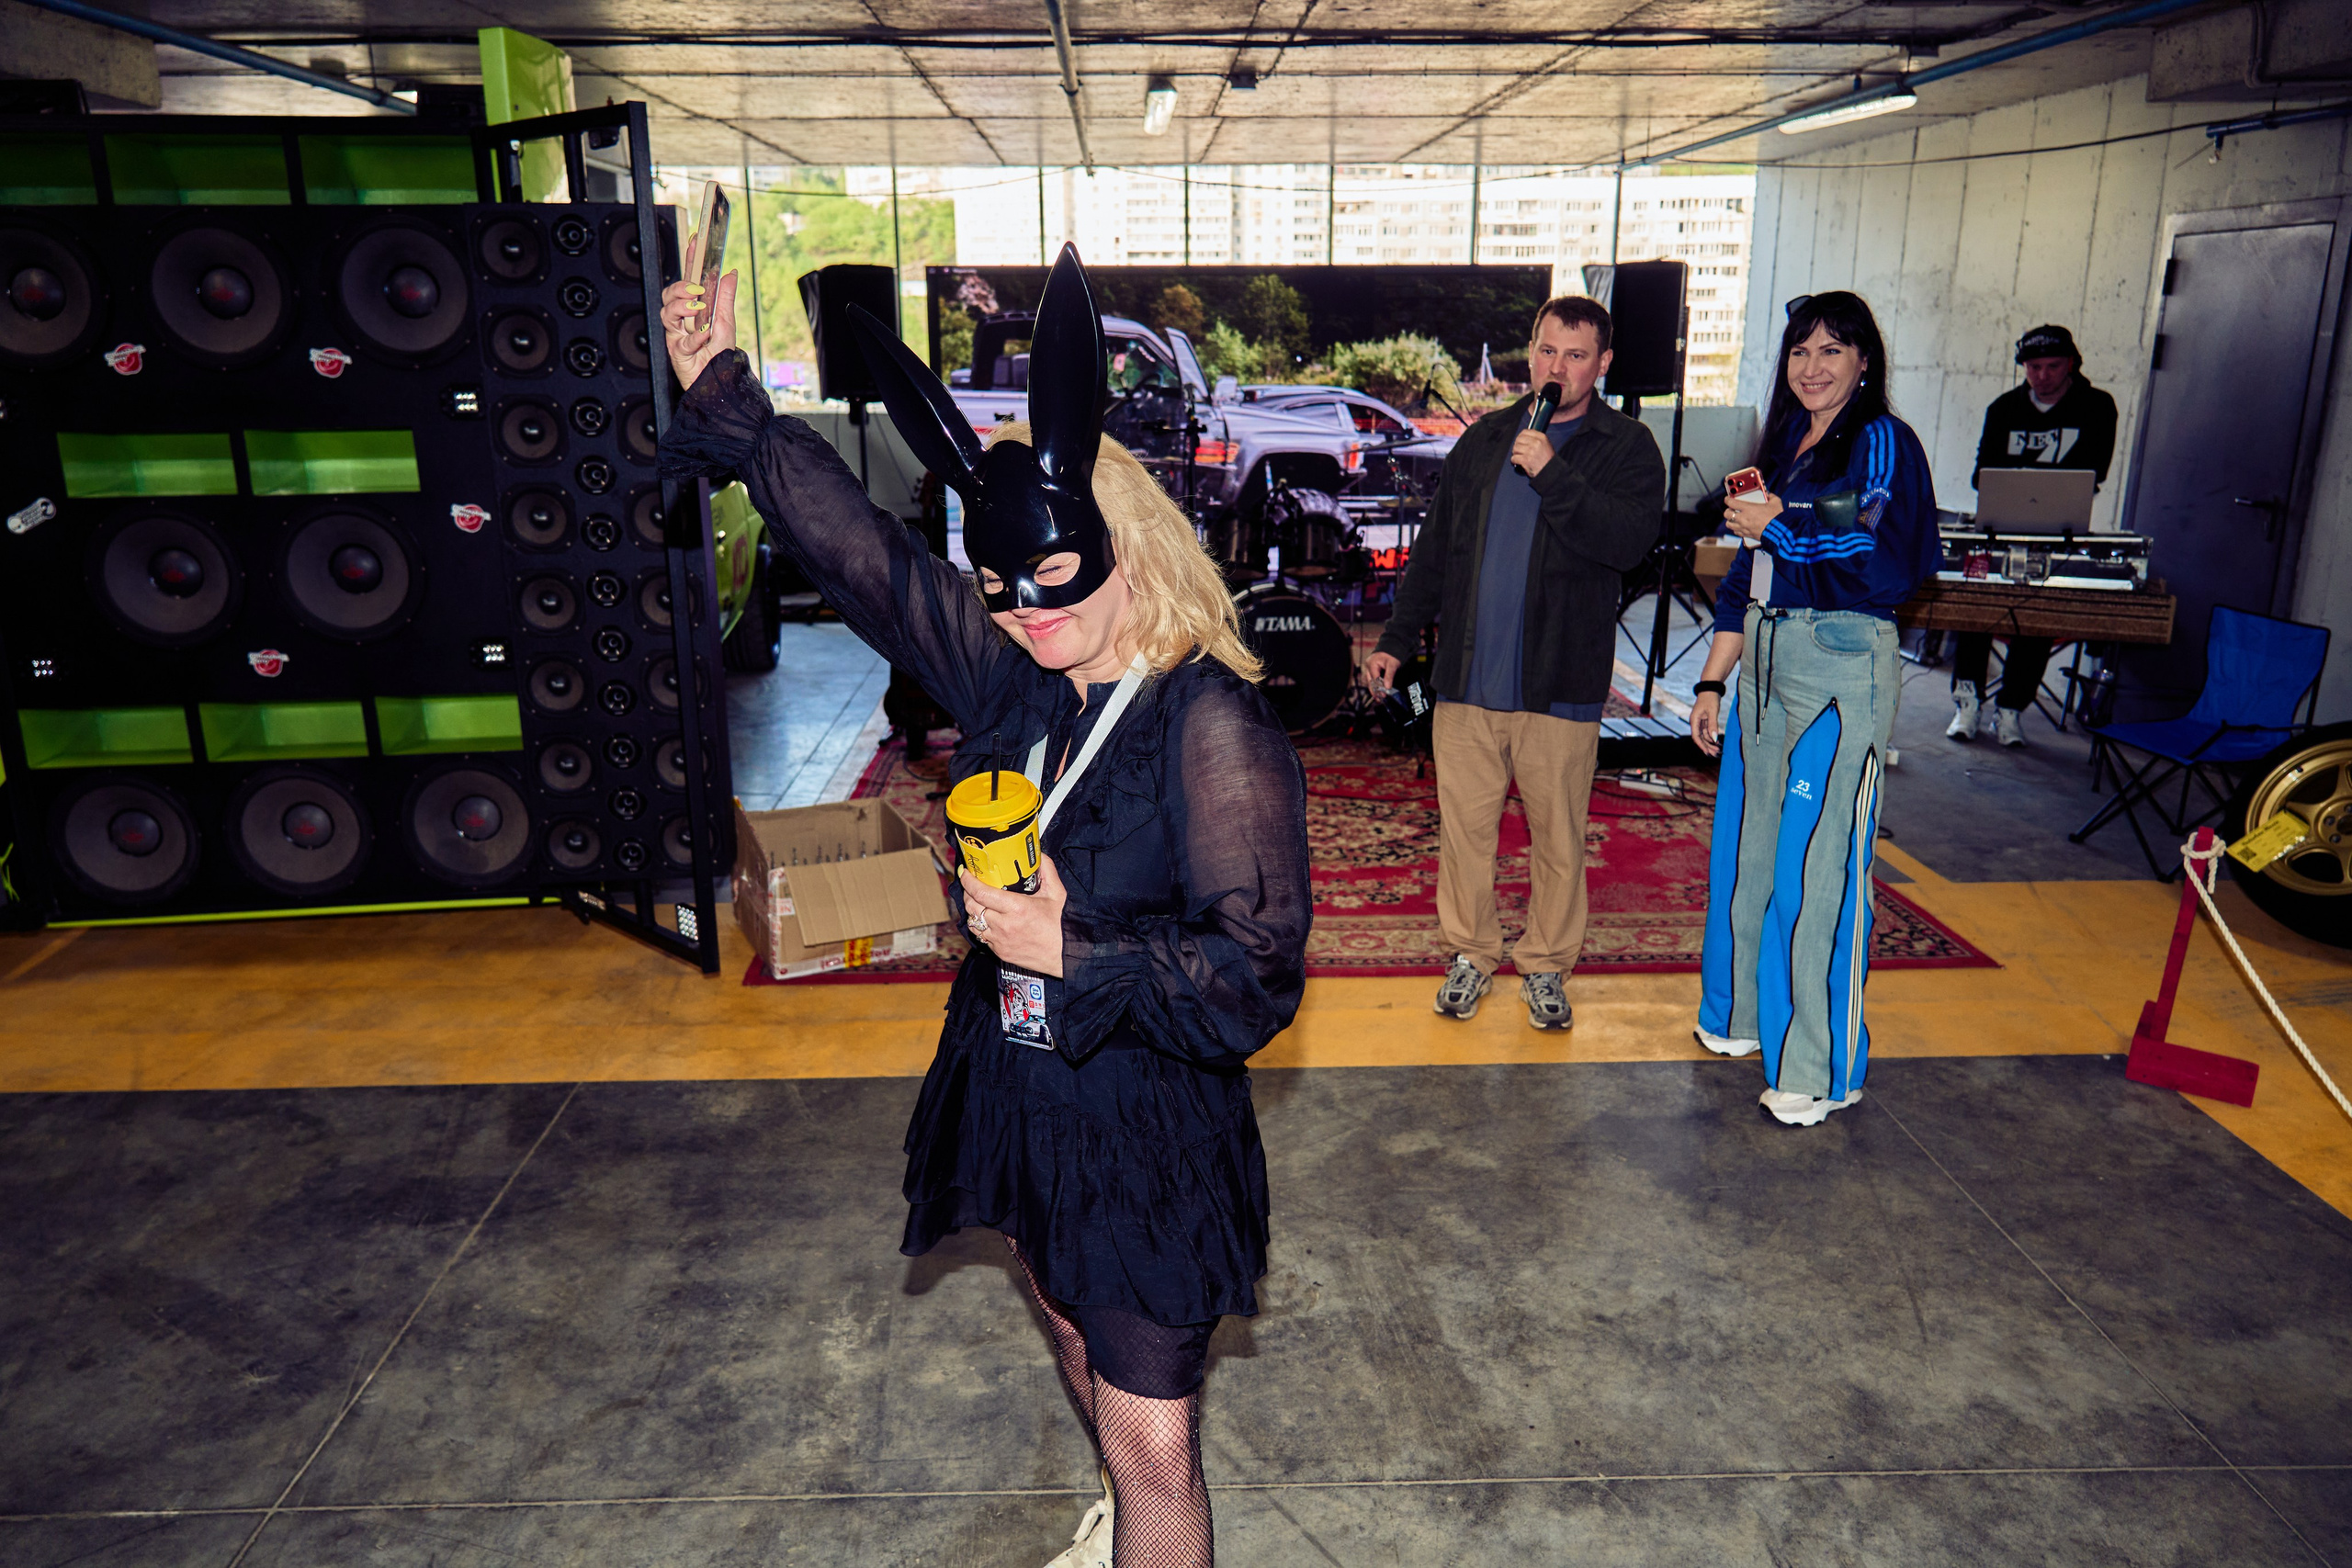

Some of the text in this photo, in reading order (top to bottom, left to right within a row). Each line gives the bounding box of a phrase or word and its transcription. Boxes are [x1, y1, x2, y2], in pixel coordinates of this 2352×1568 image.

[1265, 615, 1311, 631] TAMA
[1795, 779, 1810, 792] 23
[1790, 787, 1813, 800] seven
